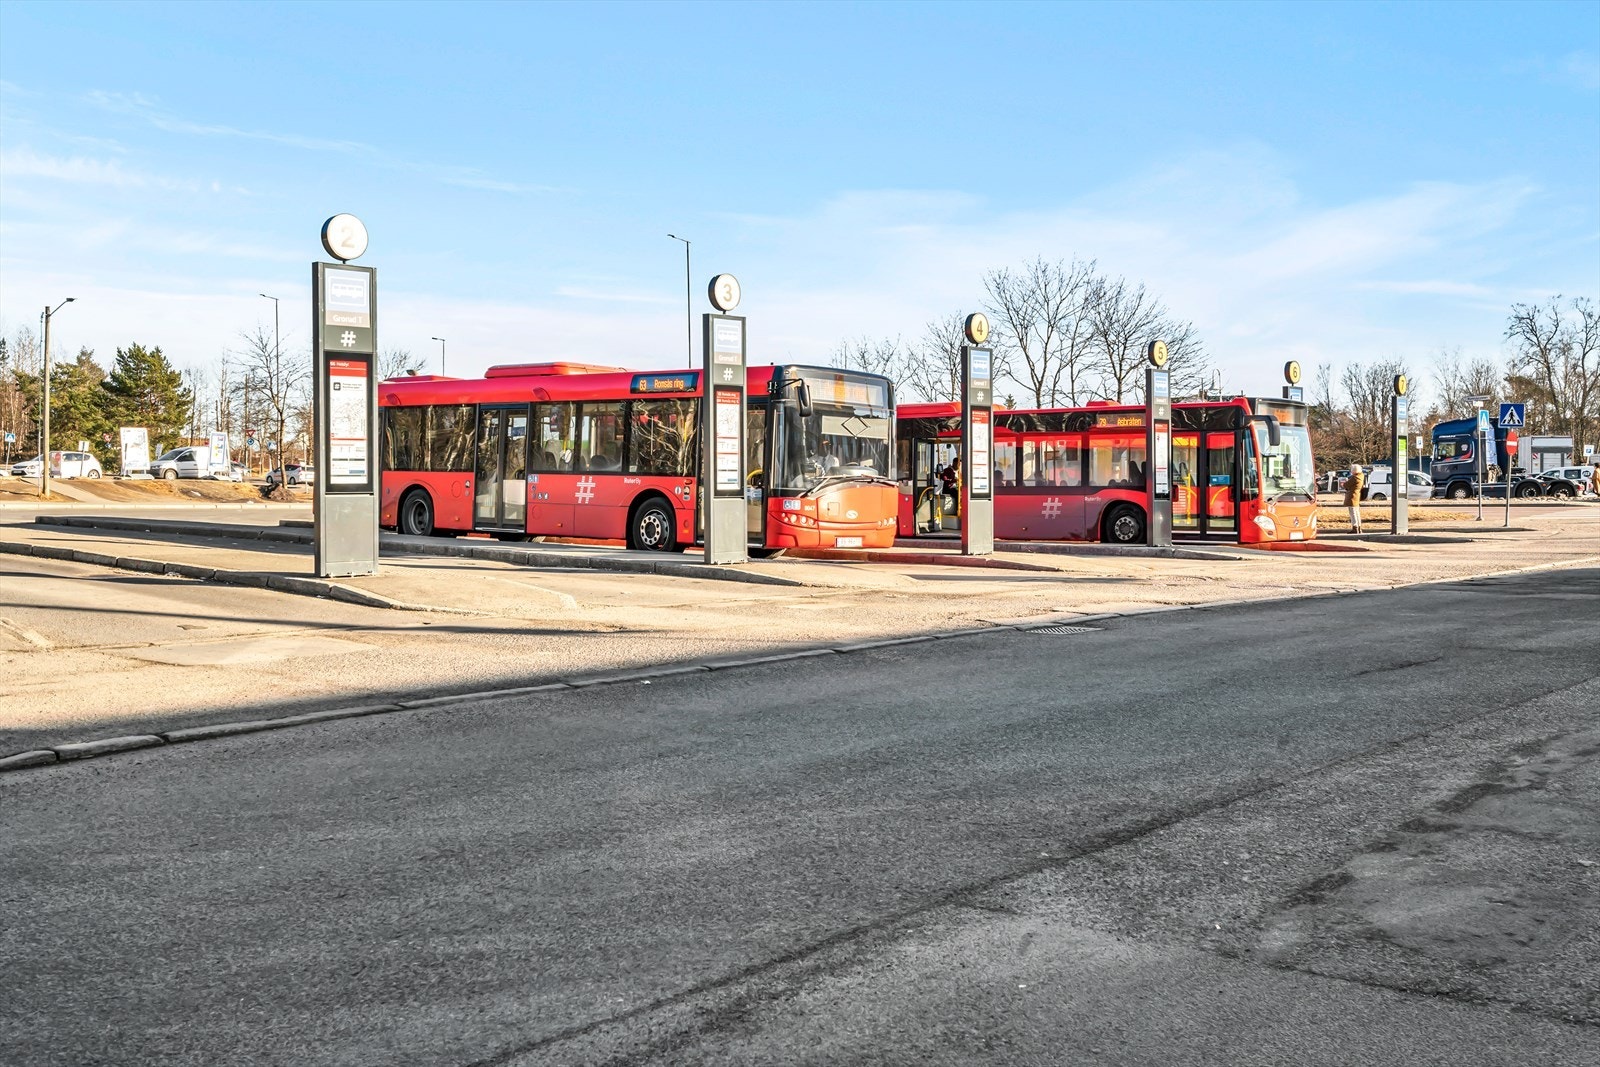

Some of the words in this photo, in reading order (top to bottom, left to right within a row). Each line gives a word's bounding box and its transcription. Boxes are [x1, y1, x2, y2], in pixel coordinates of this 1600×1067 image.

[341, 226, 355, 248] 2
[723, 283, 733, 302] 3
[976, 320, 983, 335] 4
[1158, 347, 1164, 360] 5
[1293, 366, 1298, 378] 6
[639, 379, 647, 391] 63
[673, 378, 684, 390] ring
[1401, 379, 1405, 391] 7
